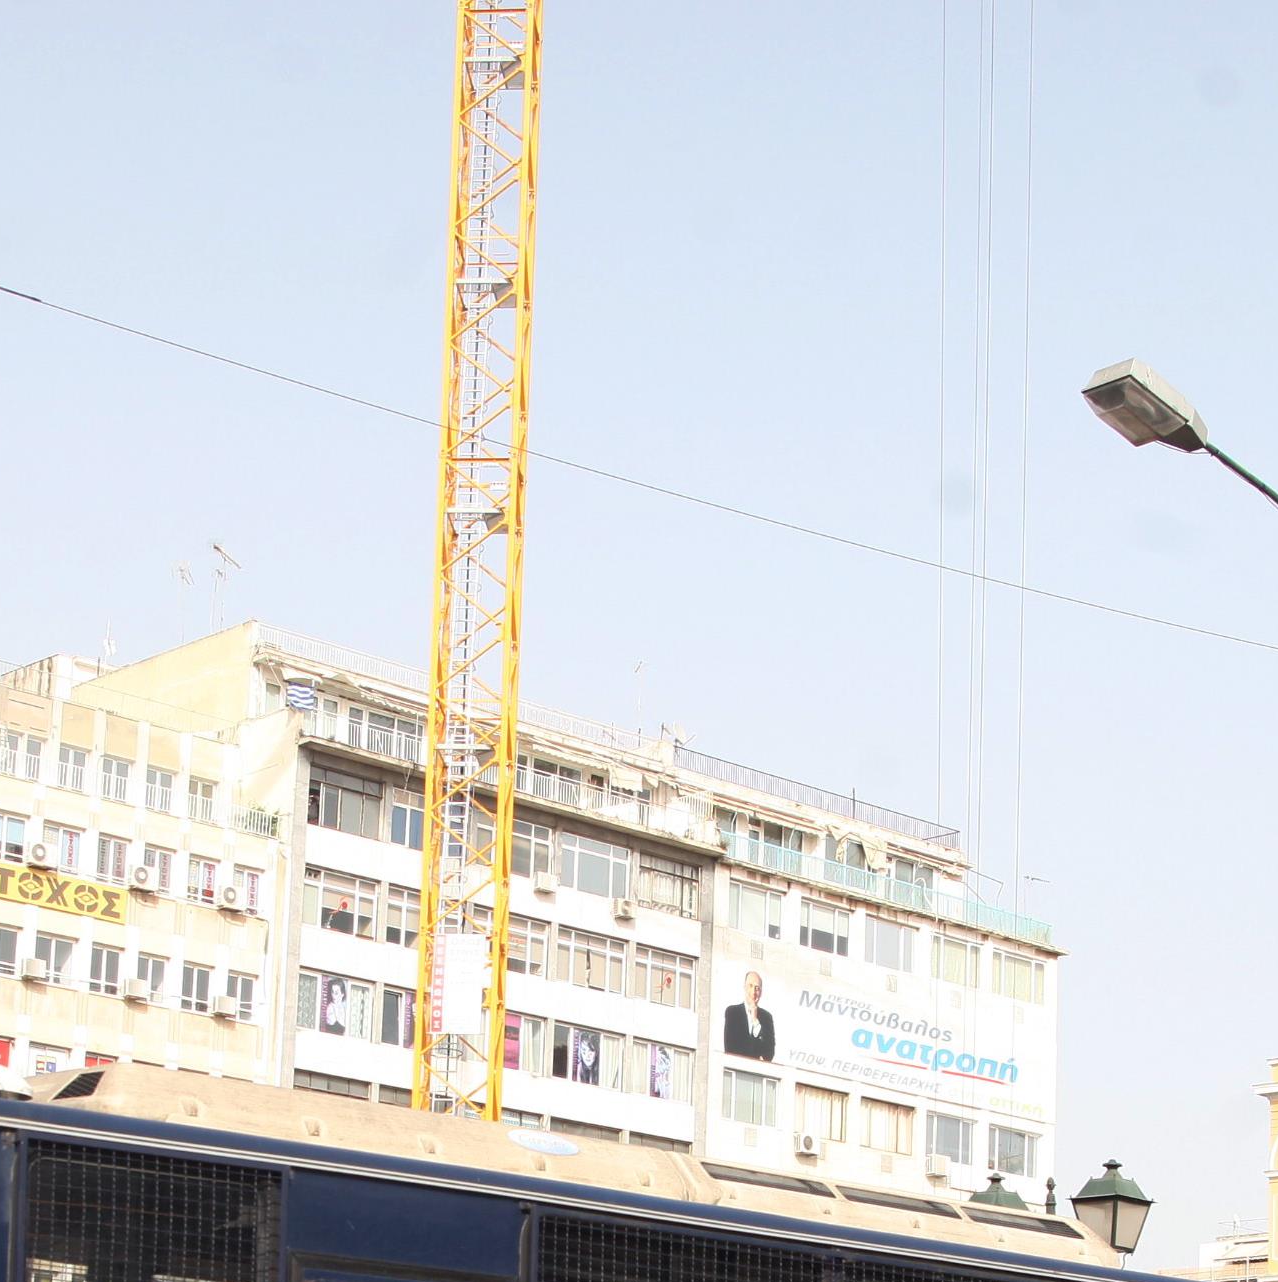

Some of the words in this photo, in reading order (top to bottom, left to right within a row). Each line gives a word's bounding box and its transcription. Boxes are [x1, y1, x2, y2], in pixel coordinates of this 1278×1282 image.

[798, 989, 953, 1043] Μαντούβαλος
[831, 1059, 943, 1094] ΠΕΡΙΦΕΡΕΙΑΡΧΗΣ
[851, 1028, 1018, 1083] ανατροπή
